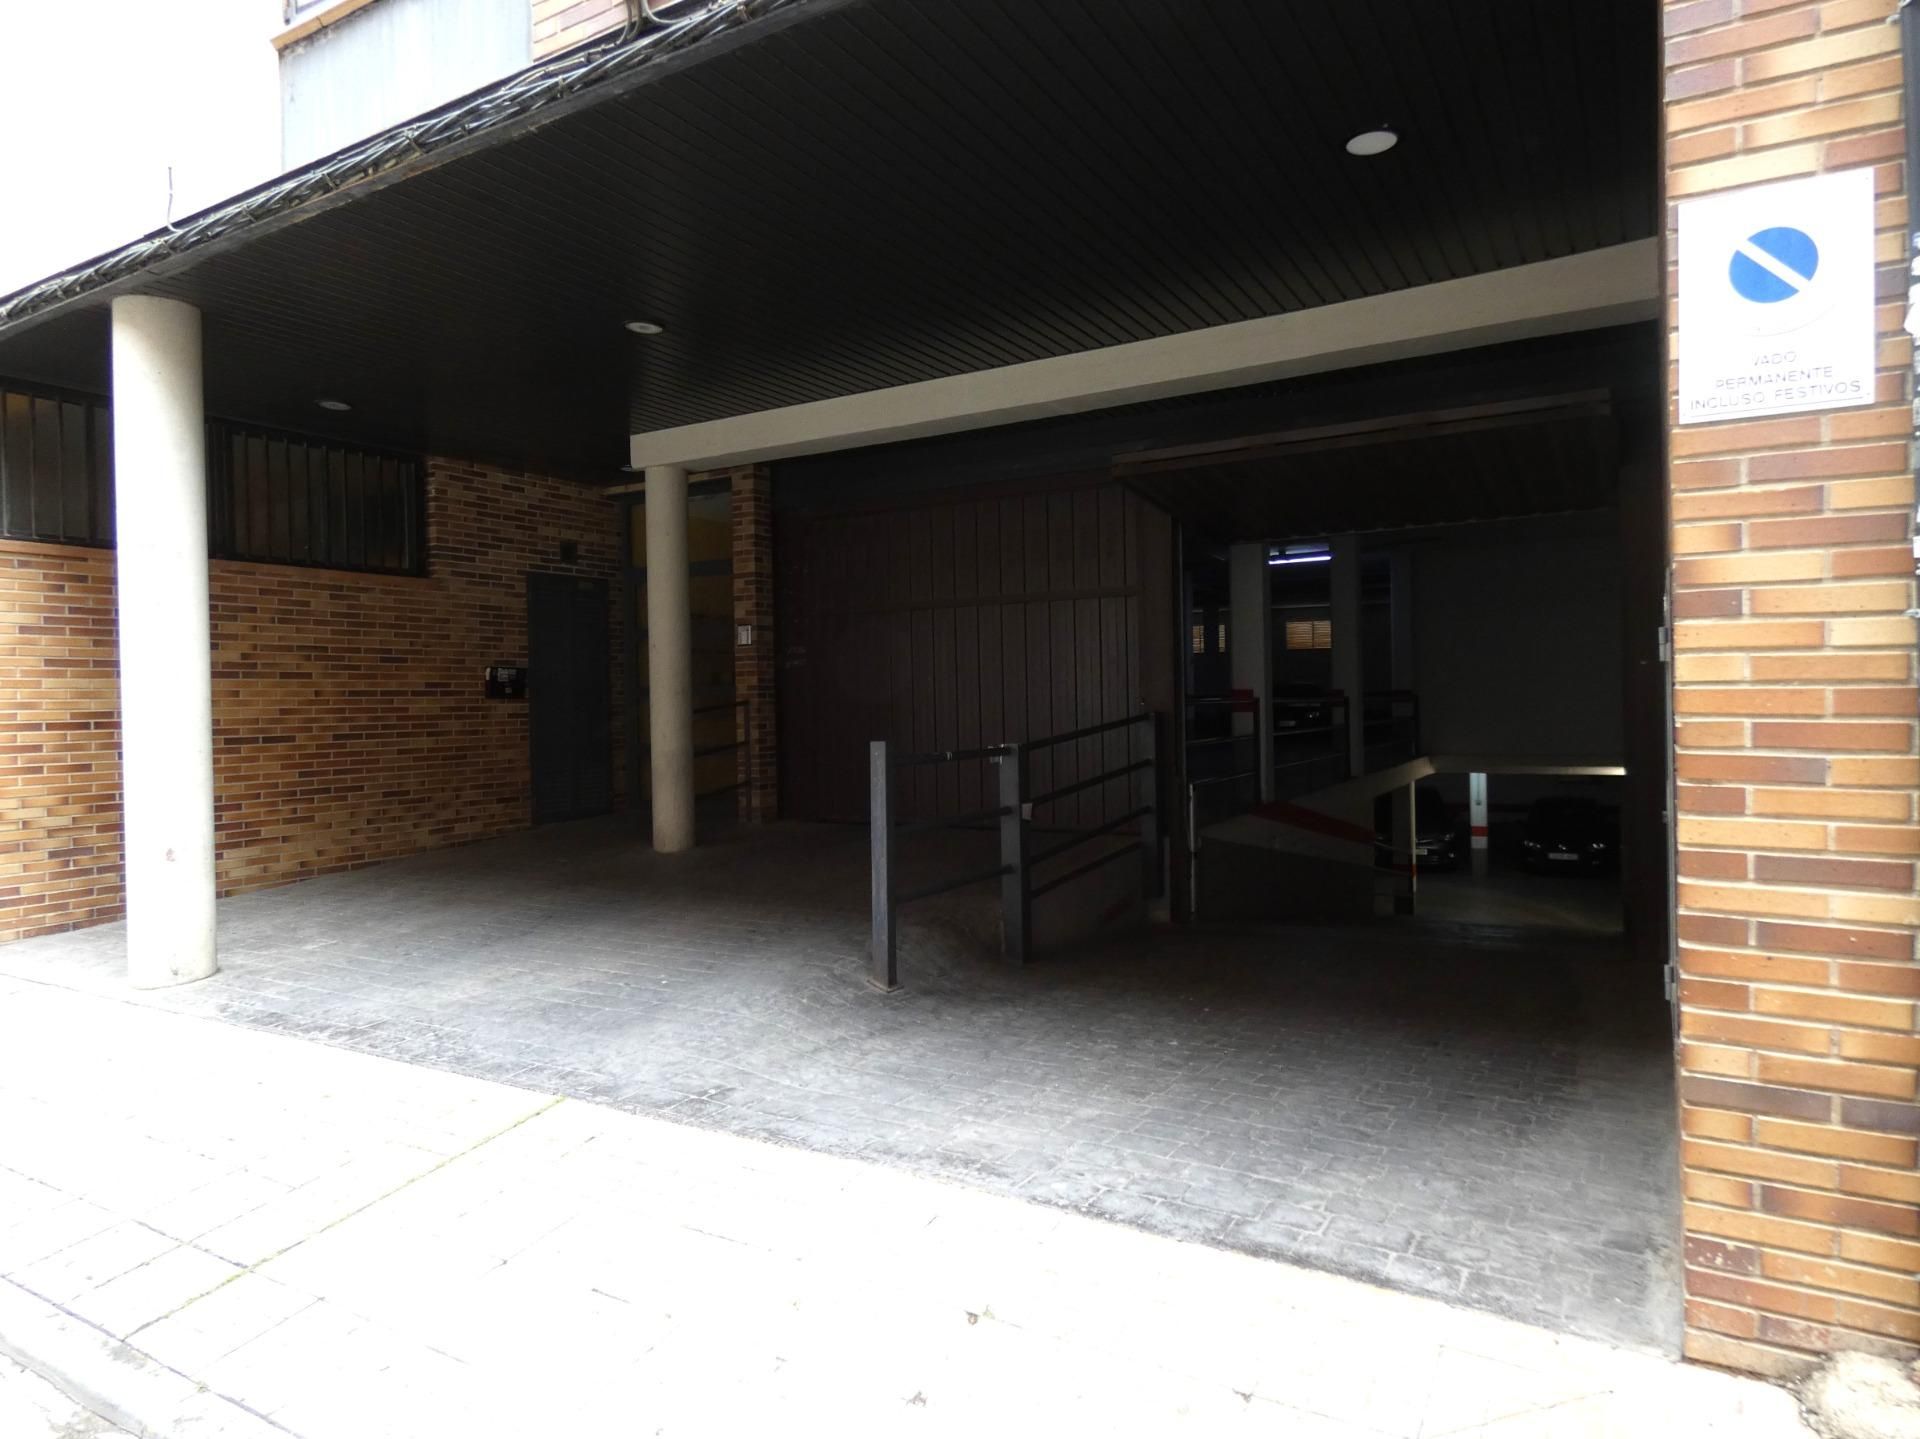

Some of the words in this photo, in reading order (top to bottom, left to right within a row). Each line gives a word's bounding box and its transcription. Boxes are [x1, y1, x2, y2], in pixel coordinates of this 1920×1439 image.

[1716, 366, 1833, 390] PERMANENTE
[1690, 392, 1765, 411] INCLUSO
[1774, 380, 1861, 401] FESTIVOS
